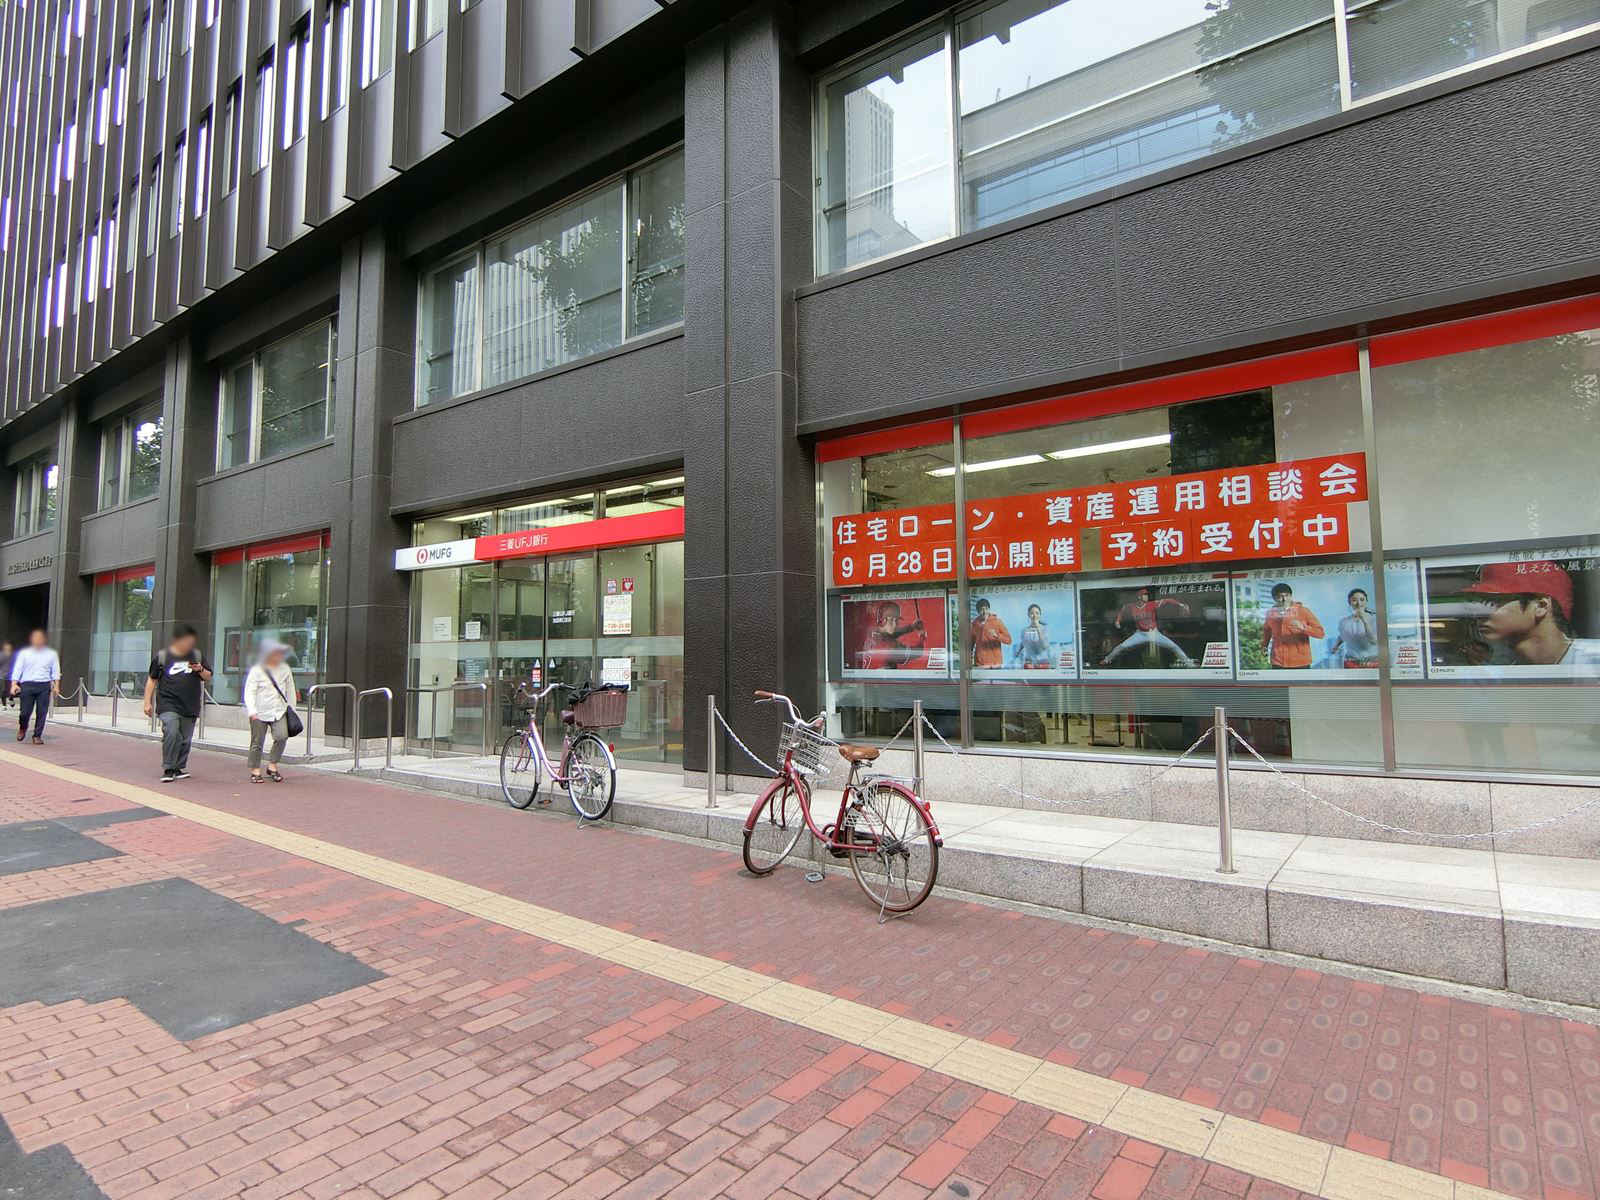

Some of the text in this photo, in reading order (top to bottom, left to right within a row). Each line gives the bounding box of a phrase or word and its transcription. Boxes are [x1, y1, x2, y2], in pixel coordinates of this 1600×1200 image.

[836, 462, 1358, 545] 住宅ローン・資産運用相談会
[499, 533, 549, 551] 三菱UFJ銀行
[1107, 514, 1338, 562] 予約受付中
[429, 547, 452, 560] MUFG
[1253, 560, 1413, 578] 資産運用とマラソンは、似いる。
[1515, 559, 1600, 574] 見えない風景
[1159, 583, 1225, 595] 信頼が生まれる。
